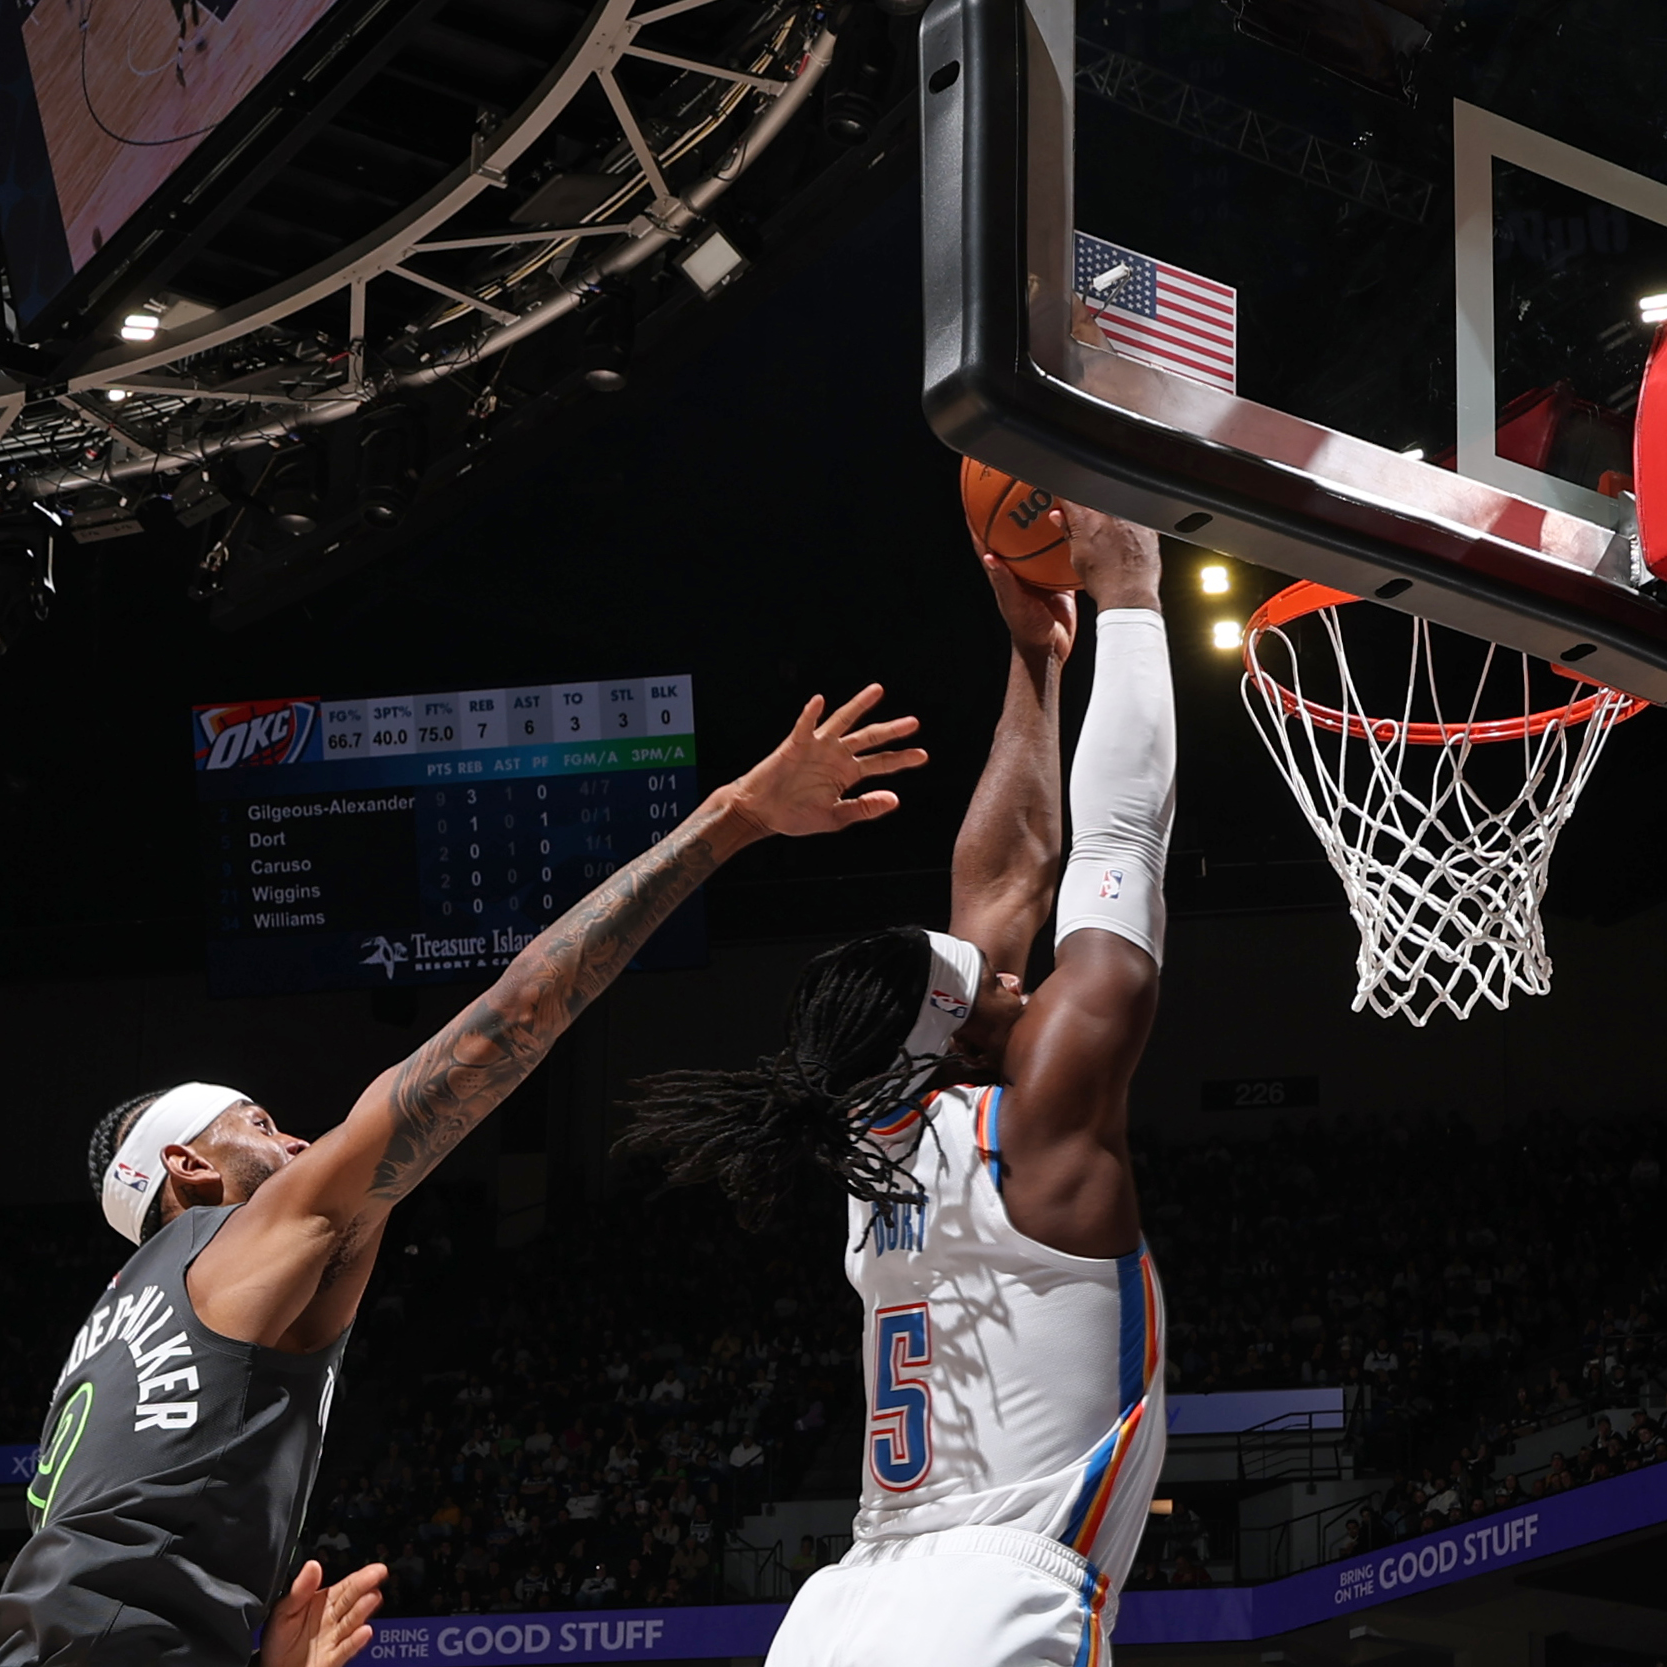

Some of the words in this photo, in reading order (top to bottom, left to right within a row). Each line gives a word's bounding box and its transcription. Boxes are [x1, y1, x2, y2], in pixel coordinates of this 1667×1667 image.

[329, 710, 362, 724] FG%
[373, 706, 412, 721] 3PT%
[424, 702, 453, 716] FT%
[469, 698, 495, 713] REB
[513, 695, 541, 709] AST
[563, 692, 583, 706] TO
[610, 688, 634, 702] STL
[650, 684, 678, 699] BLK
[328, 732, 363, 750] 66.7
[373, 729, 408, 746] 40.0
[418, 725, 454, 743] 75.0
[476, 722, 488, 739] 7
[524, 720, 535, 735] 6
[570, 716, 581, 732] 3
[618, 712, 629, 728] 3
[660, 709, 671, 725] 0
[427, 762, 453, 778] PTS
[457, 759, 484, 775] REB
[493, 756, 521, 772] AST
[532, 754, 550, 770] PF
[563, 750, 619, 768] FGM/A
[631, 746, 685, 763] 3PM/A
[247, 794, 416, 823] Gilgeous-Alexander
[466, 787, 477, 805] 3
[537, 783, 548, 800] 0
[647, 773, 677, 792] 0/1
[248, 831, 286, 849] Dort
[469, 816, 478, 833] 1
[540, 811, 549, 828] 1
[649, 801, 679, 820] 0/1
[250, 857, 312, 876] Caruso
[469, 843, 480, 860] 0
[539, 839, 550, 856] 0
[251, 883, 322, 905] Wiggins
[471, 870, 482, 887] 0
[541, 866, 552, 883] 0
[253, 911, 327, 930] Williams
[473, 898, 483, 915] 0
[542, 893, 553, 910] 0
[410, 931, 487, 959] Treasure
[491, 925, 549, 955] Islan
[414, 958, 471, 972] RESORT
[1234, 1081, 1286, 1106] 226
[869, 1301, 933, 1493] 5
[1339, 1563, 1374, 1588] BRING
[1378, 1538, 1459, 1592] GOOD
[1462, 1512, 1540, 1567] STUFF
[1334, 1586, 1350, 1605] ON
[1353, 1579, 1375, 1600] THE
[369, 1646, 398, 1659] ON
[400, 1643, 430, 1659] THE
[379, 1628, 430, 1645] BRING
[435, 1620, 552, 1658] GOOD
[557, 1618, 665, 1652] STUFF
